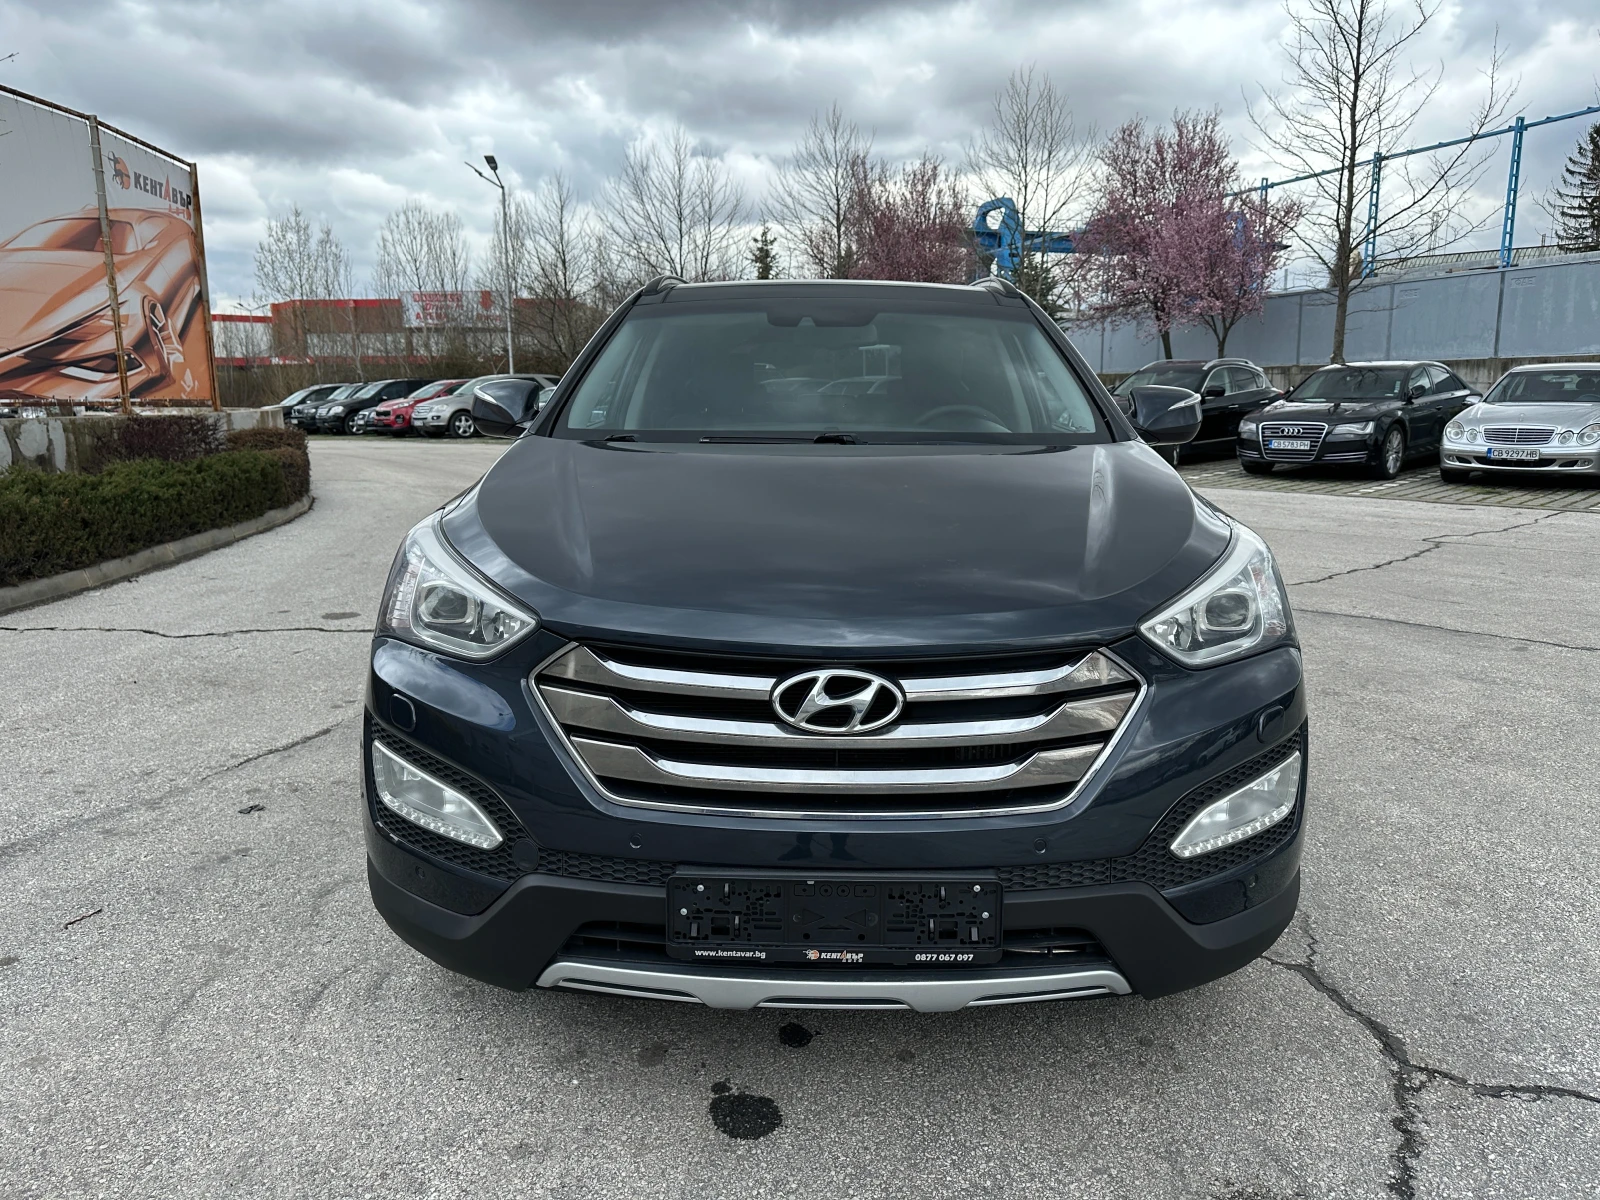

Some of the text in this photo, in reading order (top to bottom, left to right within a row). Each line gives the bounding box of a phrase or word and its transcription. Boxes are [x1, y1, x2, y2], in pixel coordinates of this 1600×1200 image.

[134, 171, 191, 209] КЕНТАВЪР
[1282, 441, 1299, 449] 5783
[1492, 449, 1538, 459] CB 9297 HB
[694, 950, 766, 959] www.kentavar.bg
[820, 950, 864, 960] КЕНТАВЪР
[915, 953, 937, 961] 0877
